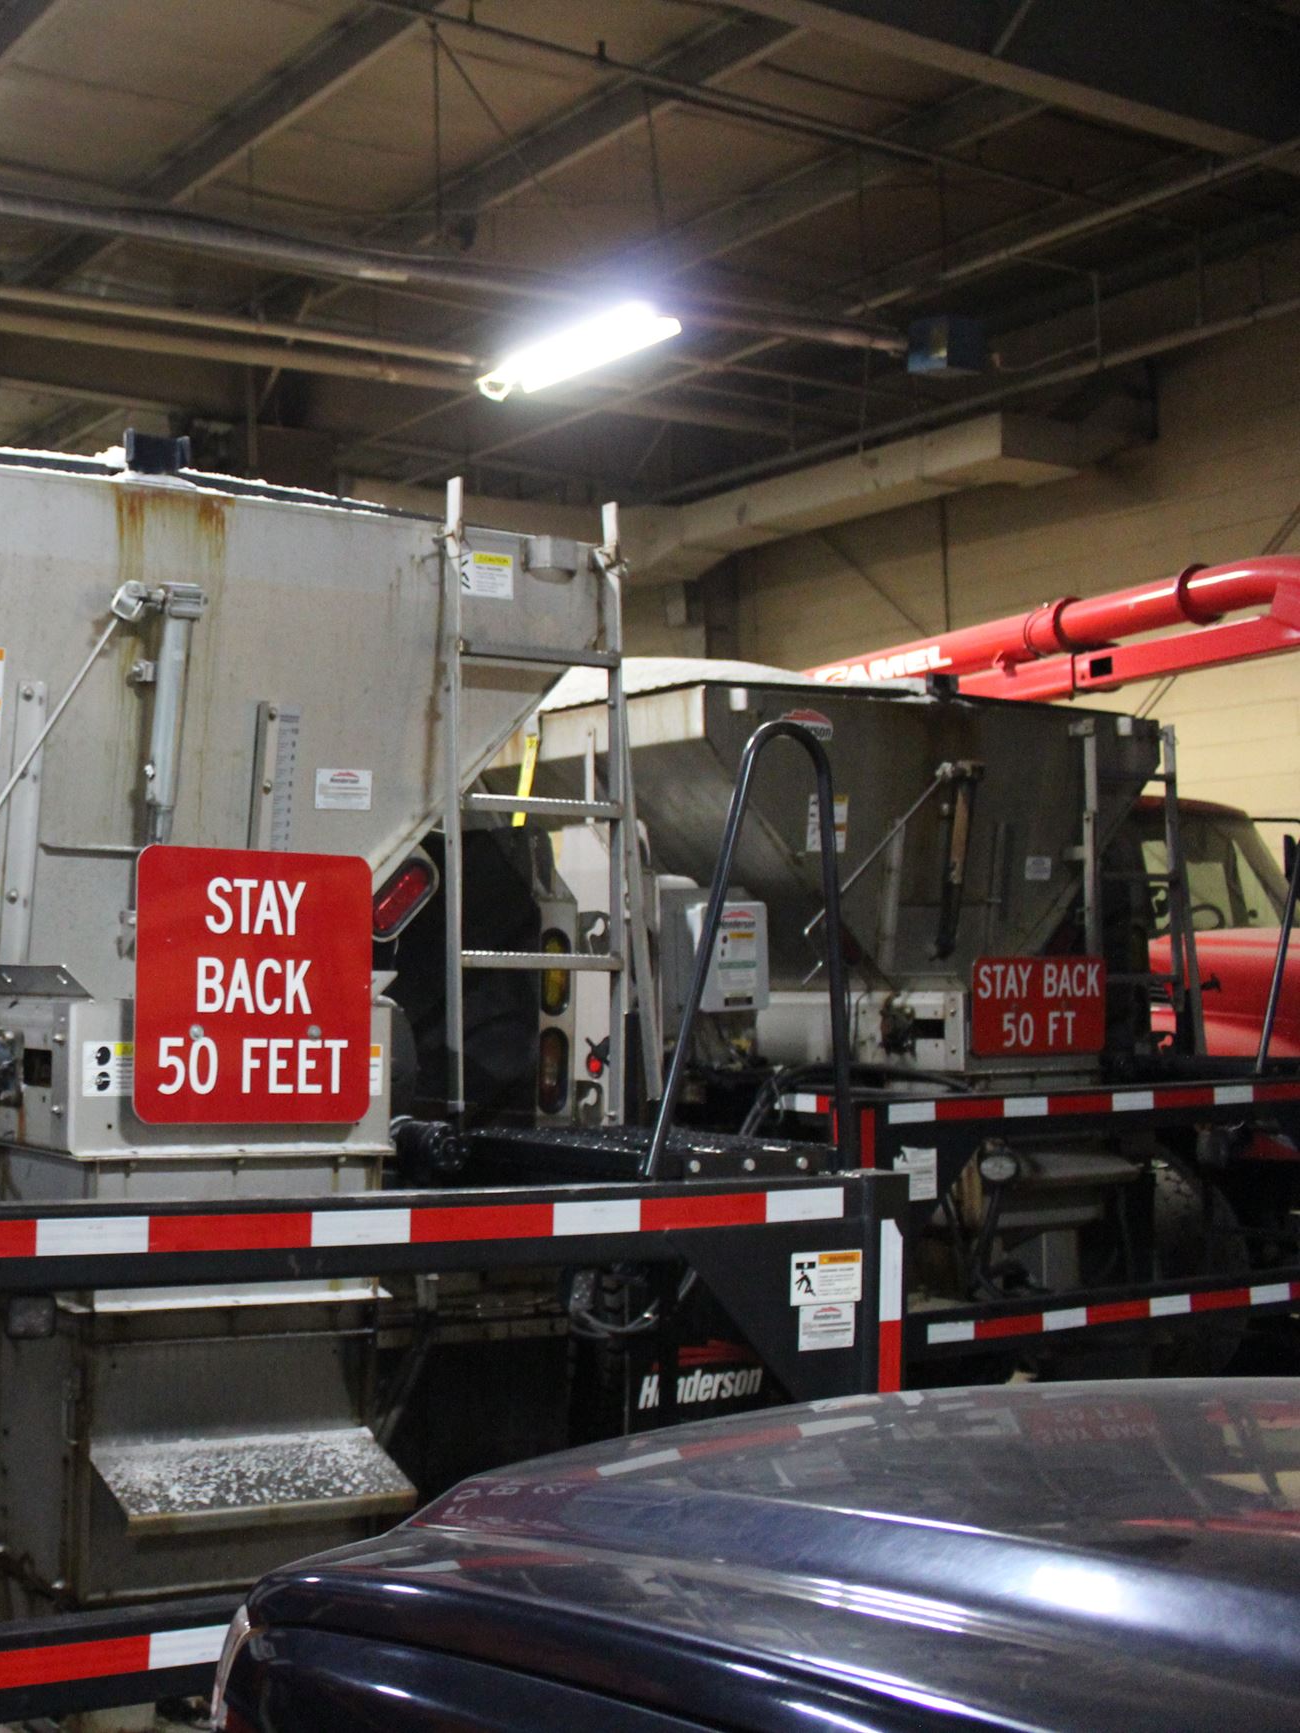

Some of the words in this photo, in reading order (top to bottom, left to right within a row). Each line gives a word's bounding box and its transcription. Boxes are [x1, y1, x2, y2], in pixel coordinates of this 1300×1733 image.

[813, 645, 953, 683] CAMEL
[205, 877, 307, 936] STAY
[196, 956, 312, 1015] BACK
[978, 964, 1033, 999] STAY
[1043, 963, 1100, 998] BACK
[1002, 1012, 1034, 1047] 50
[1048, 1011, 1076, 1046] FT
[157, 1036, 218, 1095] 50
[241, 1038, 349, 1095] FEET
